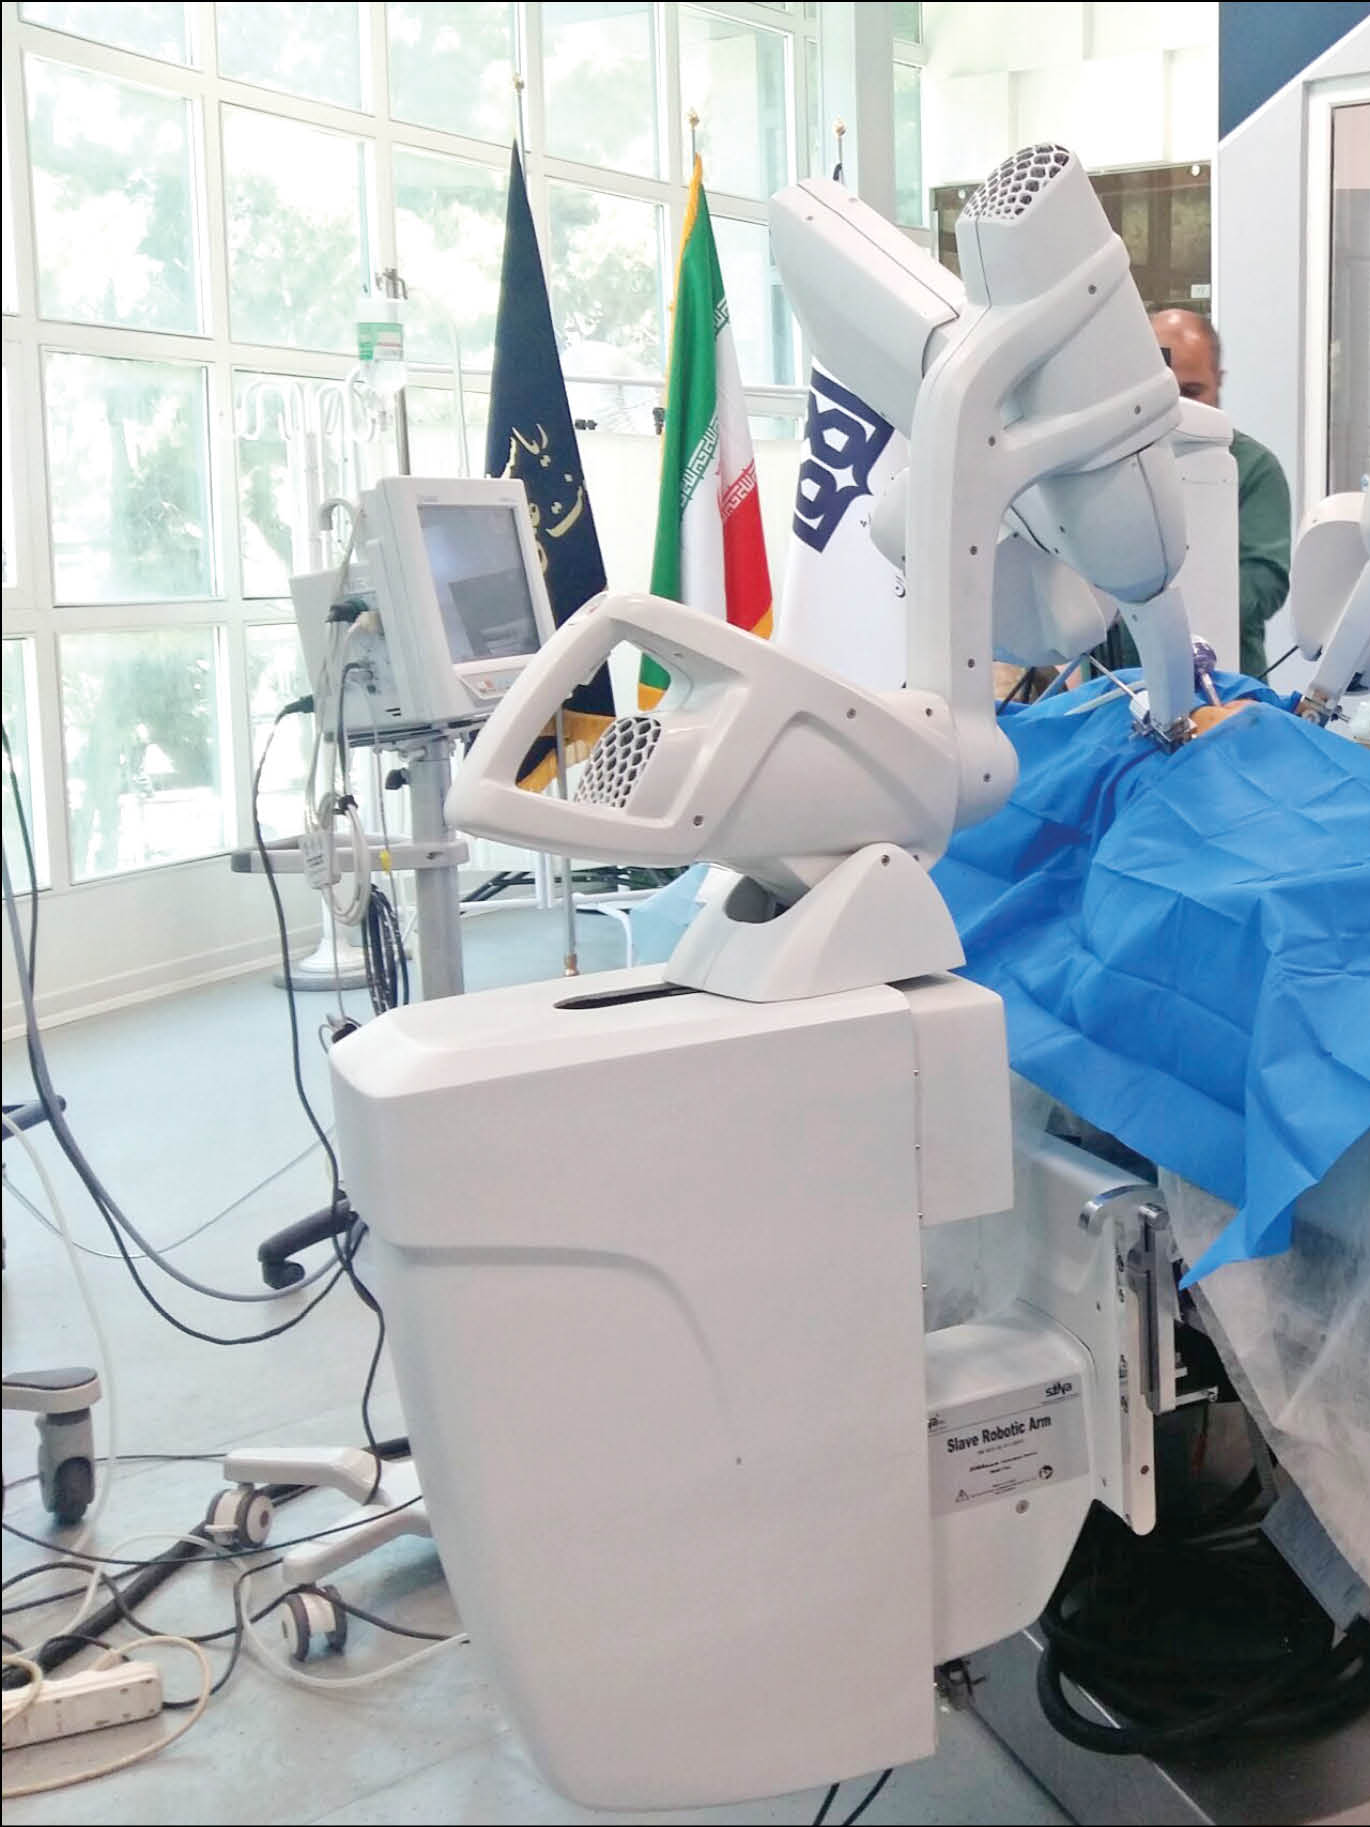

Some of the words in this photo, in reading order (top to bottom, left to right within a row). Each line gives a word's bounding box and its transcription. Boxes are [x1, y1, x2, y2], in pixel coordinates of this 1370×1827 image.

[947, 1435, 979, 1453] Slave
[982, 1421, 1025, 1443] Robotic
[1029, 1416, 1051, 1431] Arm
